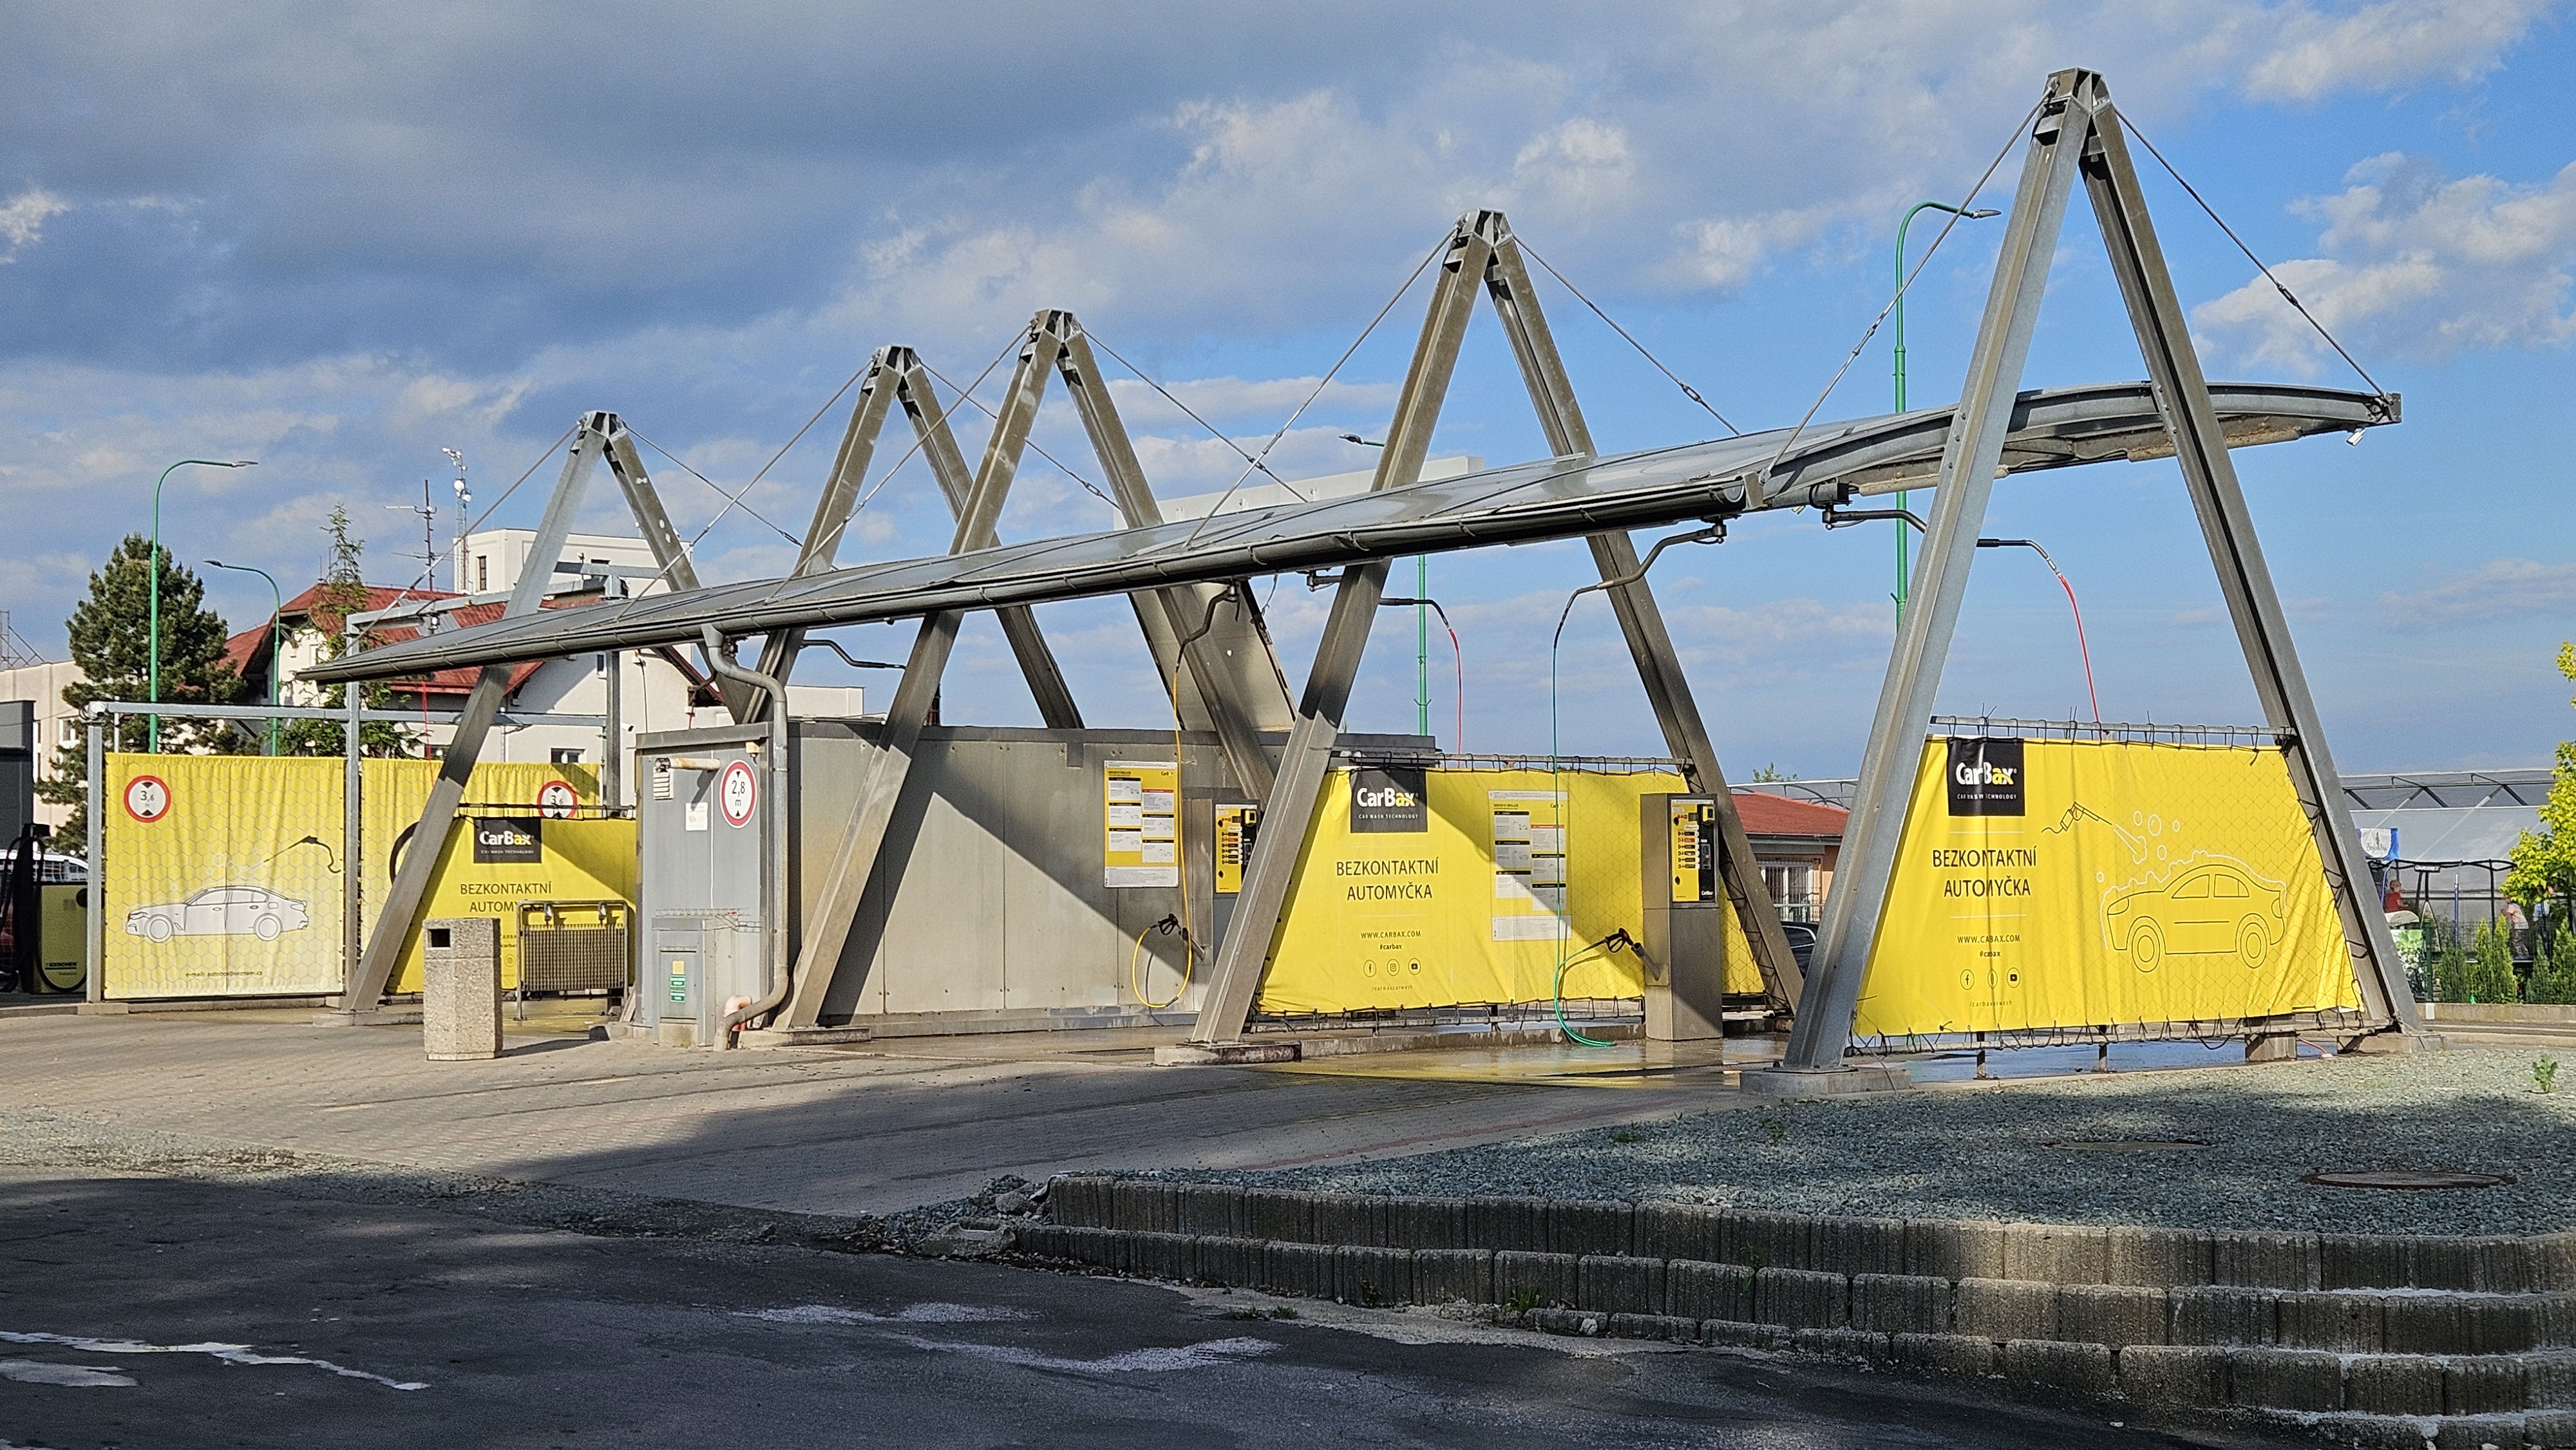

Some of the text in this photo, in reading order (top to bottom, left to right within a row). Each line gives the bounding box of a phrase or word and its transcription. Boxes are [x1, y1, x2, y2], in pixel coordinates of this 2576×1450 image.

[1956, 762, 2014, 785] CarBax
[732, 780, 745, 797] 2,8
[140, 790, 155, 802] 3,6
[551, 795, 564, 805] 36
[1357, 787, 1416, 807] CarBax
[479, 831, 532, 845] CarBax
[1336, 856, 1439, 876] BEZKONTAKTNÍ
[460, 881, 552, 895] BEZKONTAKTNÍ
[1347, 881, 1433, 901] AUTOMYČKA
[1361, 930, 1421, 939] WWW.CARBAX.COM
[1957, 934, 2020, 943] WWW.CABAX.COM
